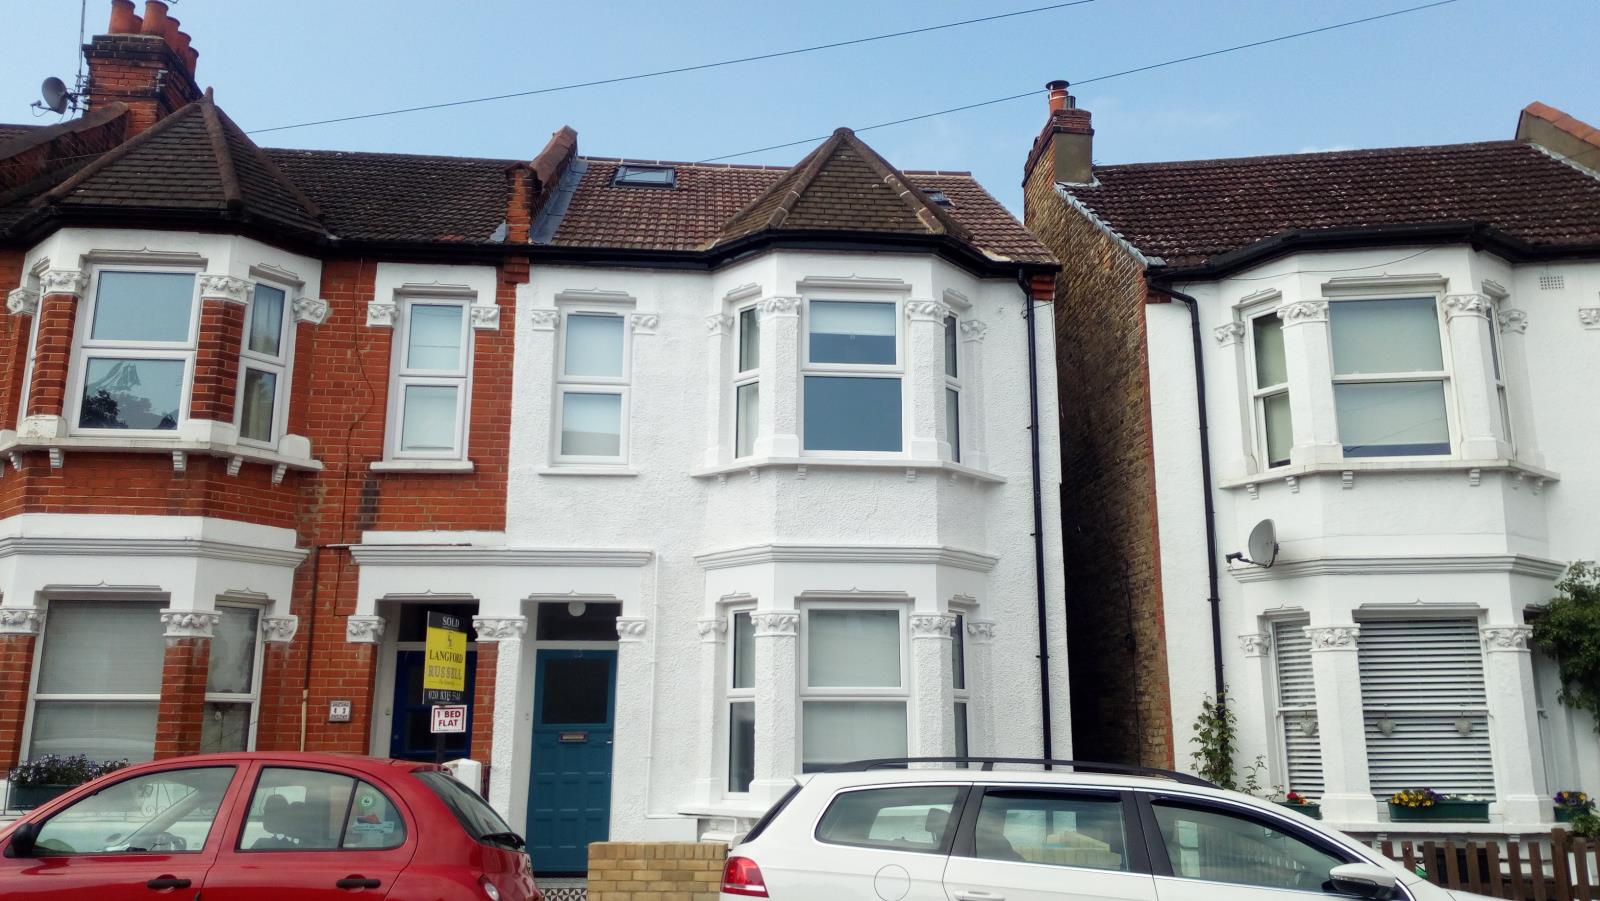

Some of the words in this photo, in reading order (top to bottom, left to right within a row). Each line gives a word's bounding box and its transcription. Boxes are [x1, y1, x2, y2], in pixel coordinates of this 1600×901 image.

[442, 616, 460, 628] SOLD
[429, 650, 463, 664] LANGFORD
[428, 665, 462, 680] RUSSELL
[444, 710, 461, 718] BED
[438, 719, 458, 727] FLAT
